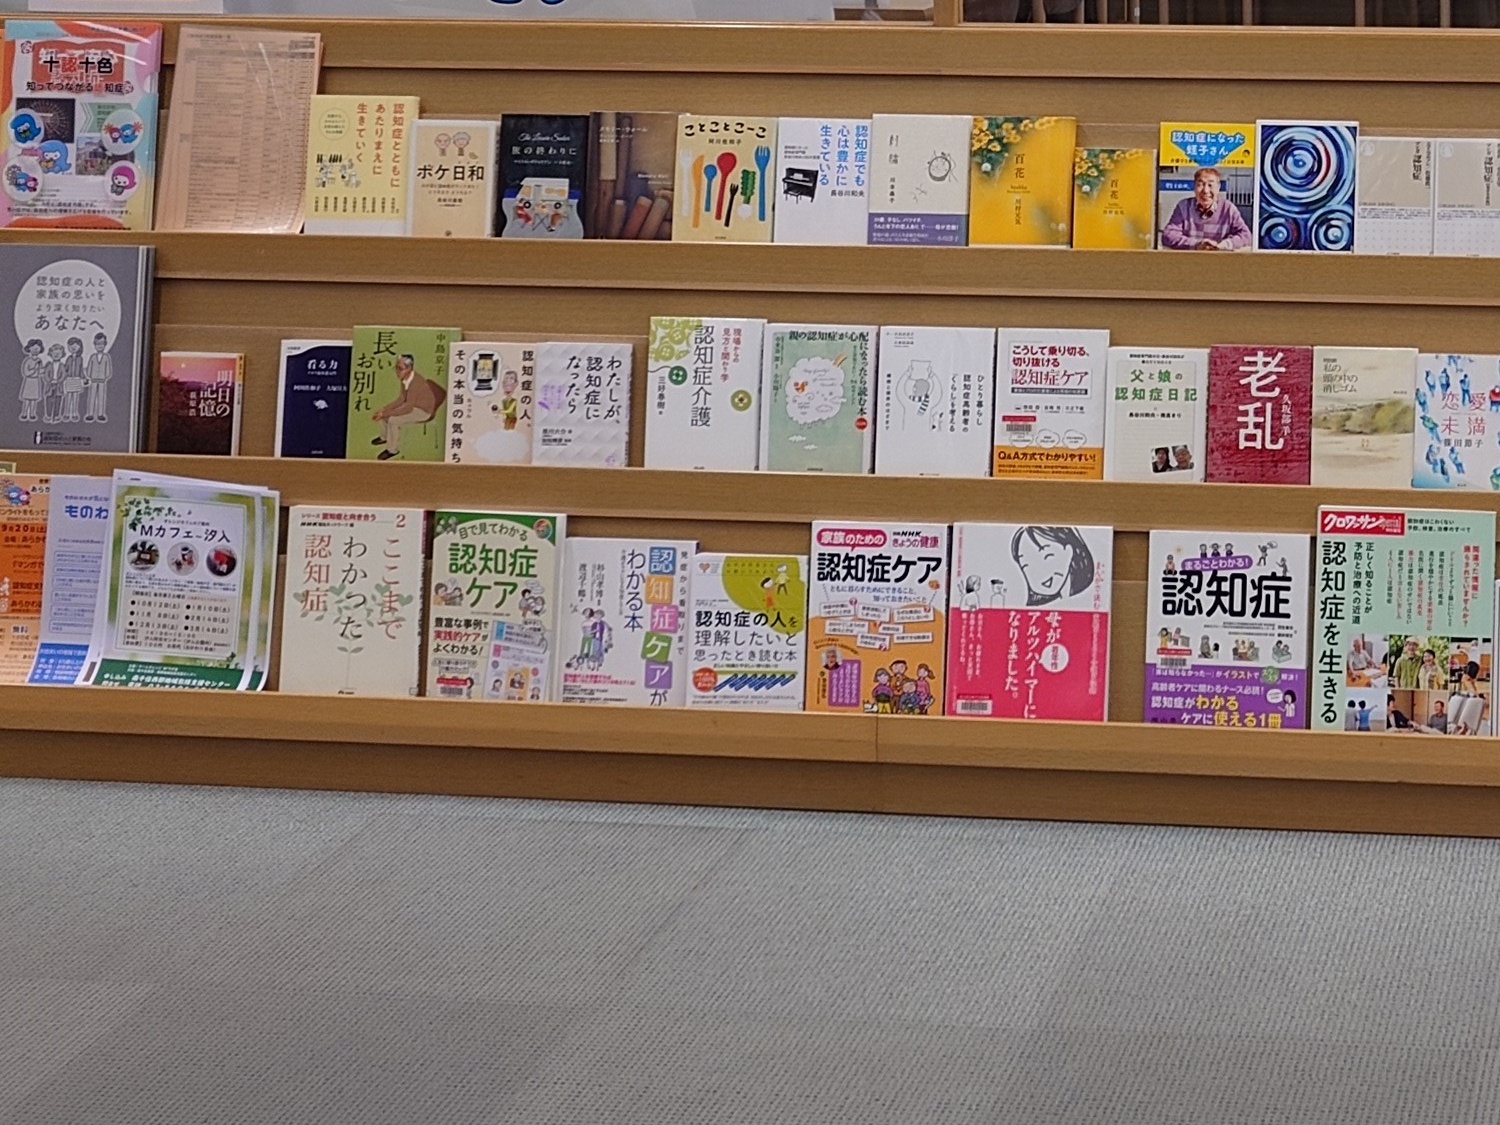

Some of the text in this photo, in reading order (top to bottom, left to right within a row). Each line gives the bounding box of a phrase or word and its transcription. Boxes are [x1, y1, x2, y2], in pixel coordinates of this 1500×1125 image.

[356, 103, 368, 164] 生きていく
[373, 103, 386, 176] あたりまえに
[390, 103, 405, 188] 認知症とともに
[1171, 131, 1245, 144] 認知症になった
[819, 124, 832, 186] 生きている
[836, 124, 850, 186] 心は豊かに
[854, 124, 868, 186] 認知症でも
[1015, 153, 1025, 180] 百花
[1109, 179, 1119, 200] 百花
[36, 276, 105, 287] 認知症の人と
[36, 289, 105, 301] 家族の思いを
[35, 315, 105, 331] あなたへ
[690, 325, 715, 427] 認知症介護
[1011, 368, 1089, 386] 認知症ケア
[1012, 357, 1060, 368] 切り抜ける
[1130, 368, 1183, 383] 父と娘の
[1323, 362, 1342, 373] 私の
[566, 355, 582, 415] なったら
[584, 356, 602, 421] 認知症に
[1115, 387, 1198, 402] 認知症日記
[1237, 350, 1286, 451] 老乱
[450, 349, 466, 464] その本当の気持ち
[395, 513, 406, 528] 2
[458, 523, 528, 541] 目で見てわかる
[821, 531, 884, 546] 家族のための
[300, 533, 332, 613] 認知症
[448, 542, 539, 578] 認知症
[817, 552, 942, 584] 認知症ケア
[339, 536, 368, 640] わかった
[378, 536, 403, 640] ここまで
[466, 577, 518, 609] ケア
[624, 549, 646, 633] わかる本
[1162, 569, 1292, 619] 認知症
[1365, 542, 1375, 614] 正しく知ることが
[434, 617, 489, 630] 豊富な事例で
[695, 610, 797, 627] 認知症の人を
[1319, 540, 1347, 724] 認知症を生きる
[694, 631, 797, 646] 理解したいと
[694, 649, 797, 662] 思ったとき読む本
[1151, 695, 1239, 709] 認知症がわかる
